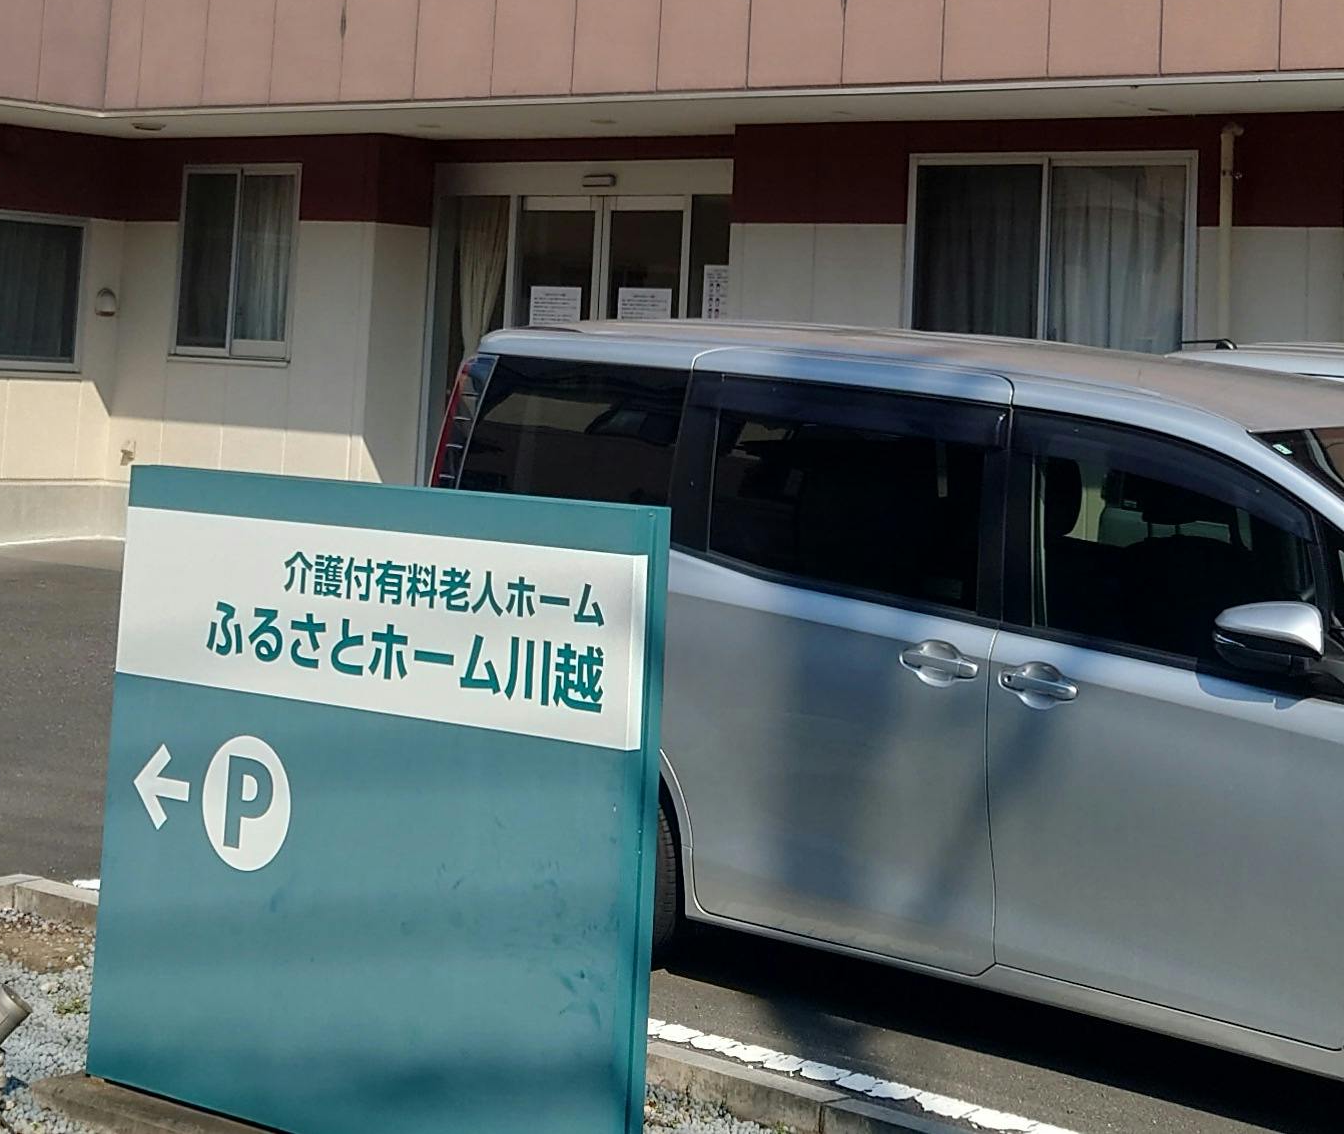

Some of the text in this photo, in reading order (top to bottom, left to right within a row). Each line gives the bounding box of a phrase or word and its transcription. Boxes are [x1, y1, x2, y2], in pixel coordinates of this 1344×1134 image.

[284, 551, 605, 627] 介護付有料老人ホーム
[206, 602, 605, 714] ふるさとホーム川越
[223, 754, 274, 849] P
